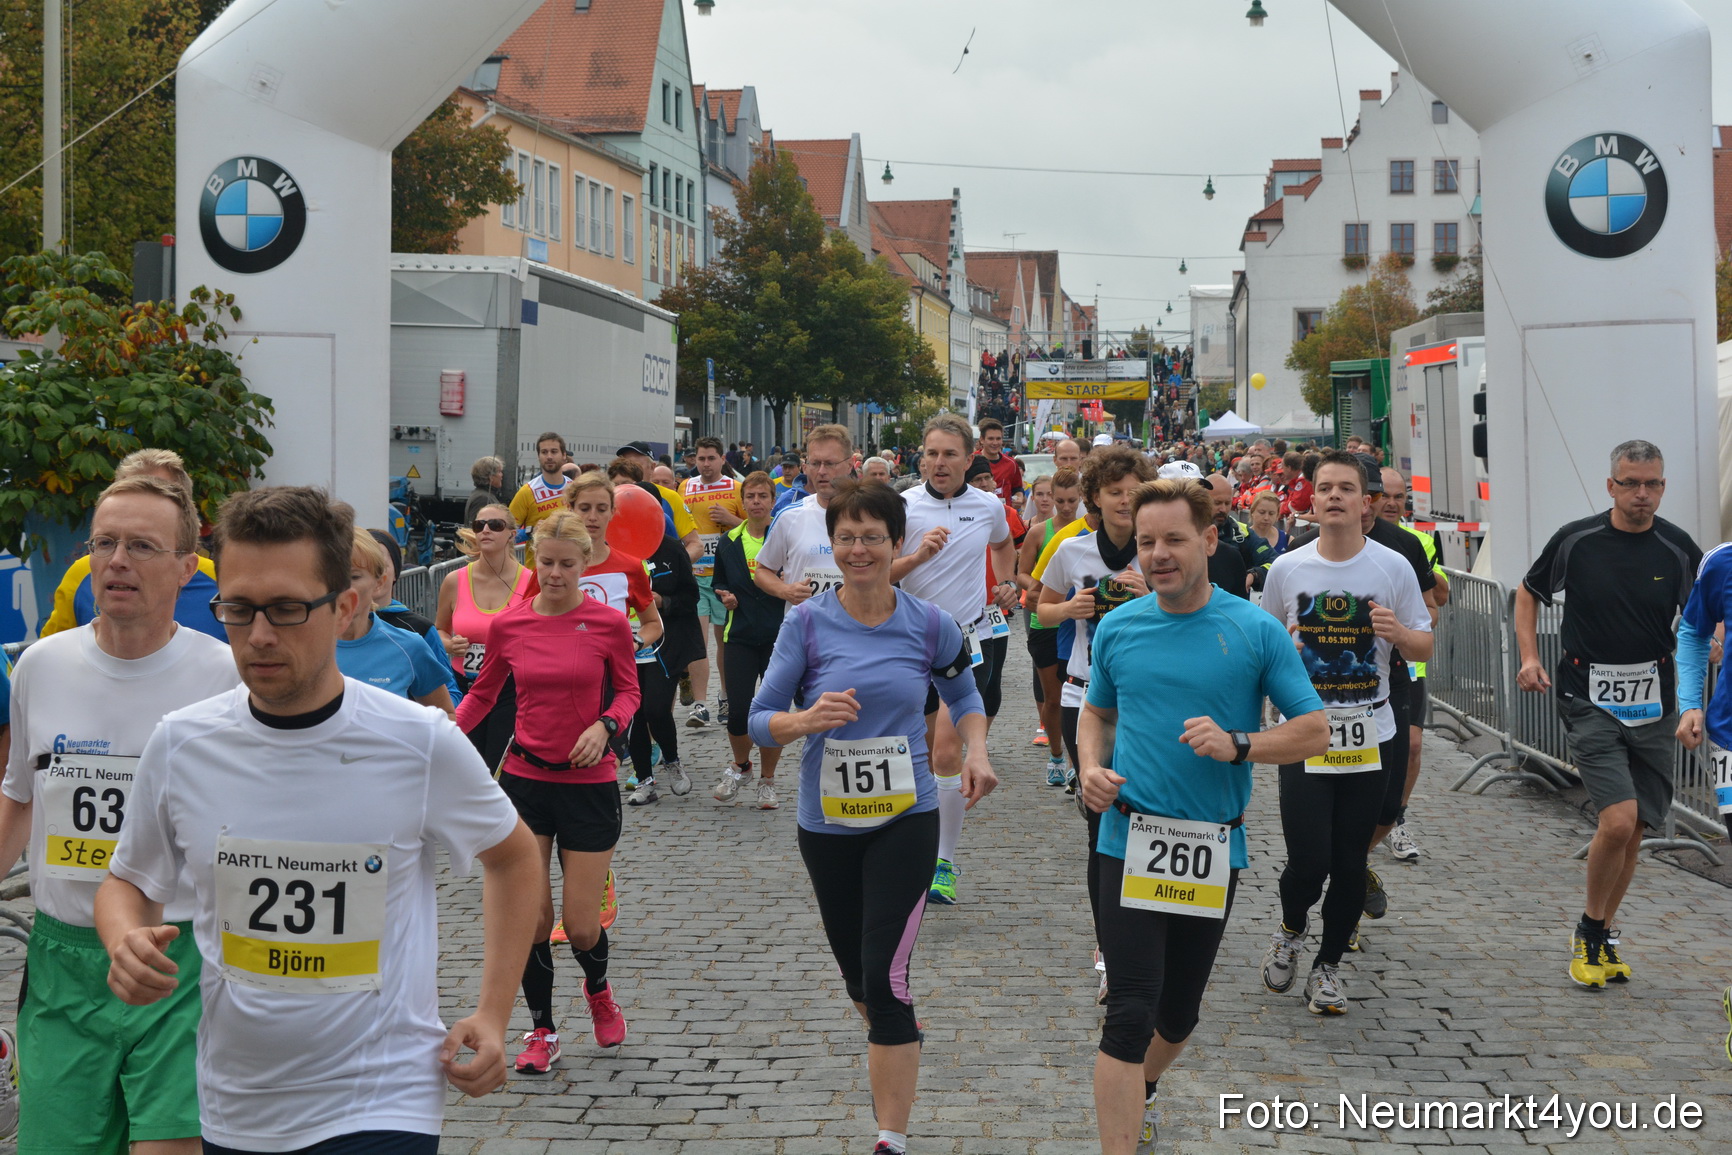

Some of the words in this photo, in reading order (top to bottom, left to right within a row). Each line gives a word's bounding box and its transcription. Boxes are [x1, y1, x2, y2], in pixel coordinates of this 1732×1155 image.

[1555, 136, 1659, 178] BMW
[206, 159, 298, 197] BMW
[642, 353, 671, 396] BOCK
[1066, 385, 1108, 396] START
[708, 493, 735, 501] BÖGL
[537, 502, 558, 512] MAX
[809, 580, 843, 597] 24
[1327, 625, 1360, 634] Running
[1591, 669, 1615, 678] PARTL
[1616, 669, 1649, 678] Neumarkt
[1597, 677, 1654, 703] 2577
[1330, 712, 1365, 722] Neumarkt
[66, 739, 111, 749] Neumarkter
[824, 746, 847, 758] PARTL
[848, 746, 894, 757] Neumarkt
[1323, 754, 1363, 764] Andreas
[50, 766, 92, 779] PARTL
[834, 759, 892, 794] 151
[1711, 755, 1732, 785] 91
[73, 786, 125, 834] 63
[840, 801, 894, 815] Katarina
[1131, 822, 1166, 836] PARTL
[1167, 827, 1215, 841] Neumarkt
[60, 839, 114, 866] Ste
[217, 851, 273, 869] PARTL
[277, 856, 358, 873] Neumarkt
[1146, 839, 1213, 880] 260
[1154, 883, 1195, 902] Alfred
[248, 877, 346, 935] 231
[268, 948, 325, 976] Björn
